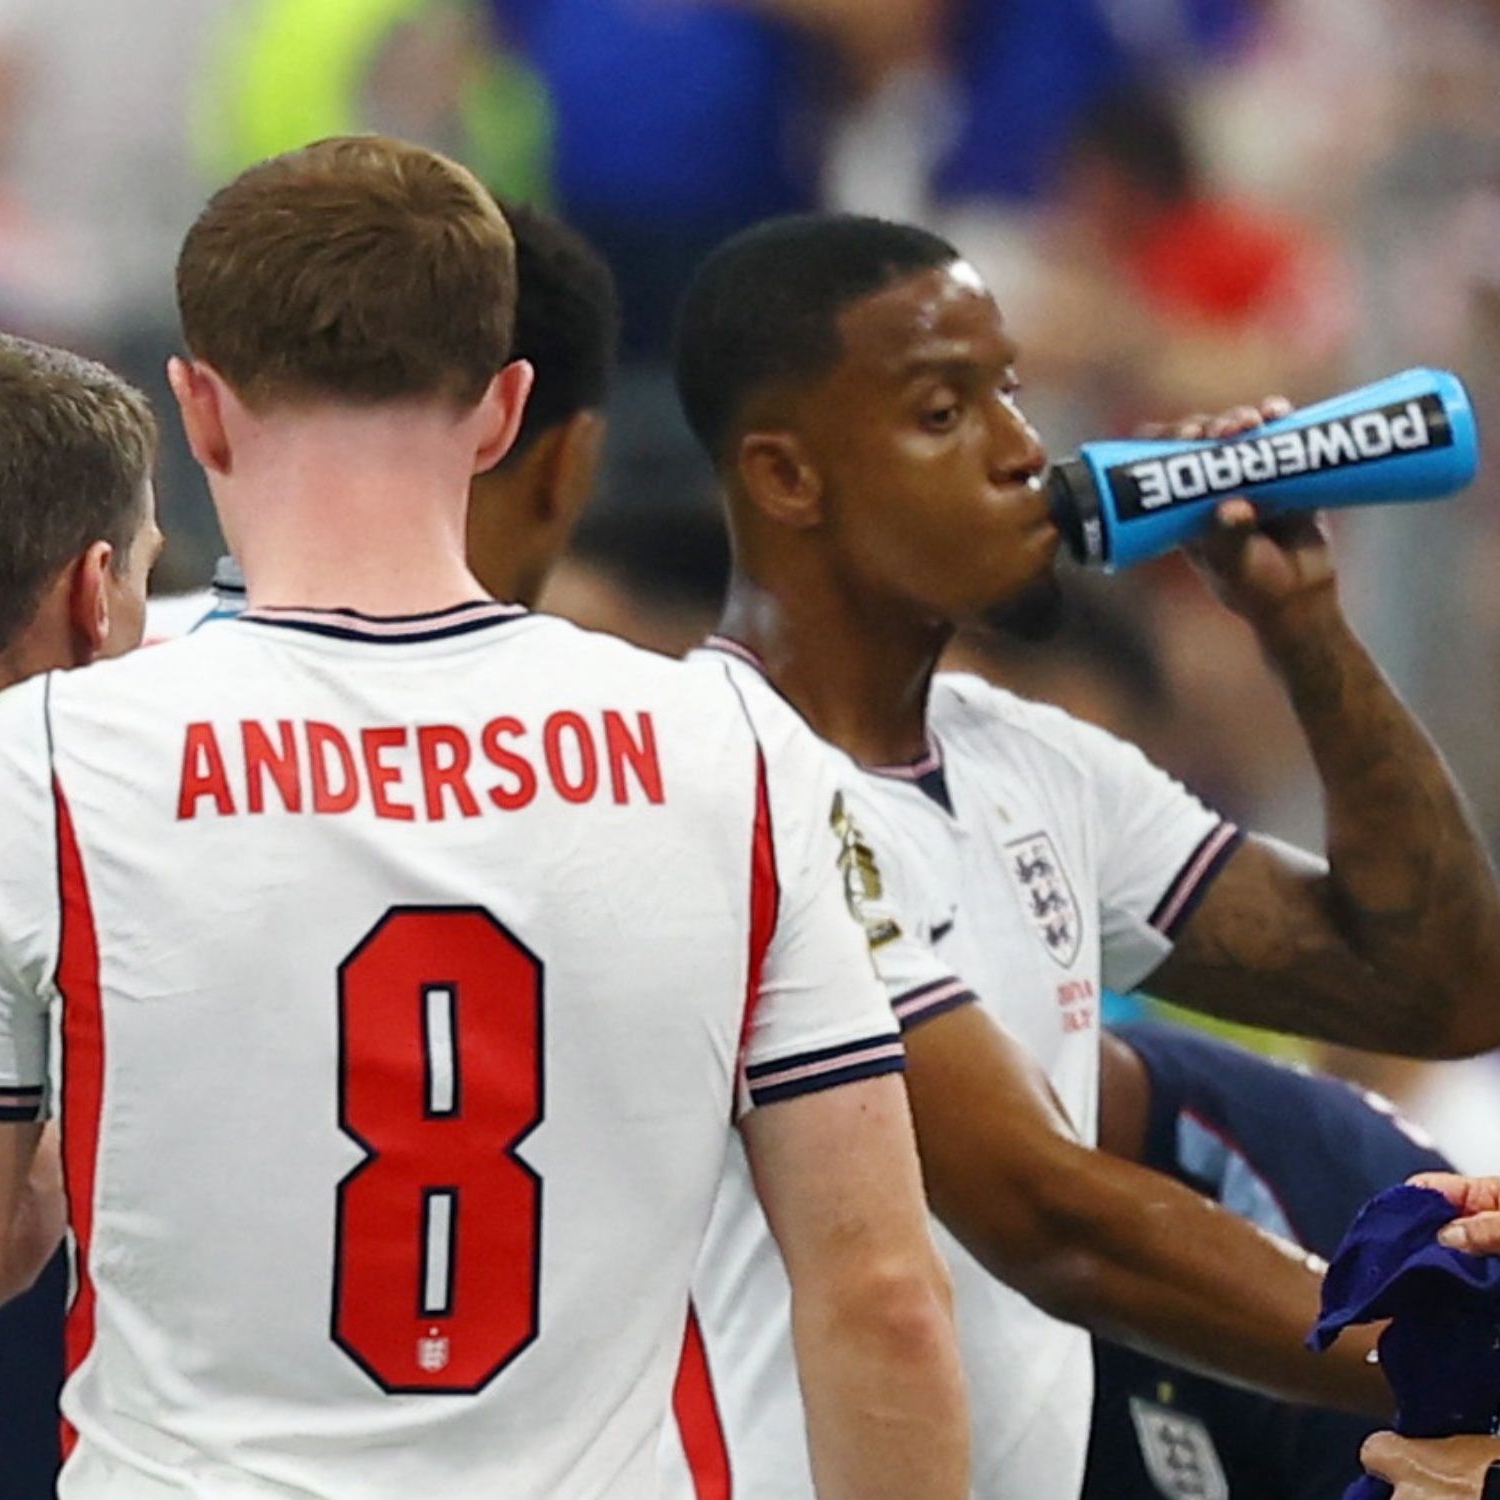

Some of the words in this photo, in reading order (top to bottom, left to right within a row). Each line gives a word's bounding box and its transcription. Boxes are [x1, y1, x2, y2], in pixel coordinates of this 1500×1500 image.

[1129, 401, 1431, 511] POWERADE
[176, 709, 665, 822] ANDERSON
[329, 904, 545, 1395] 8
